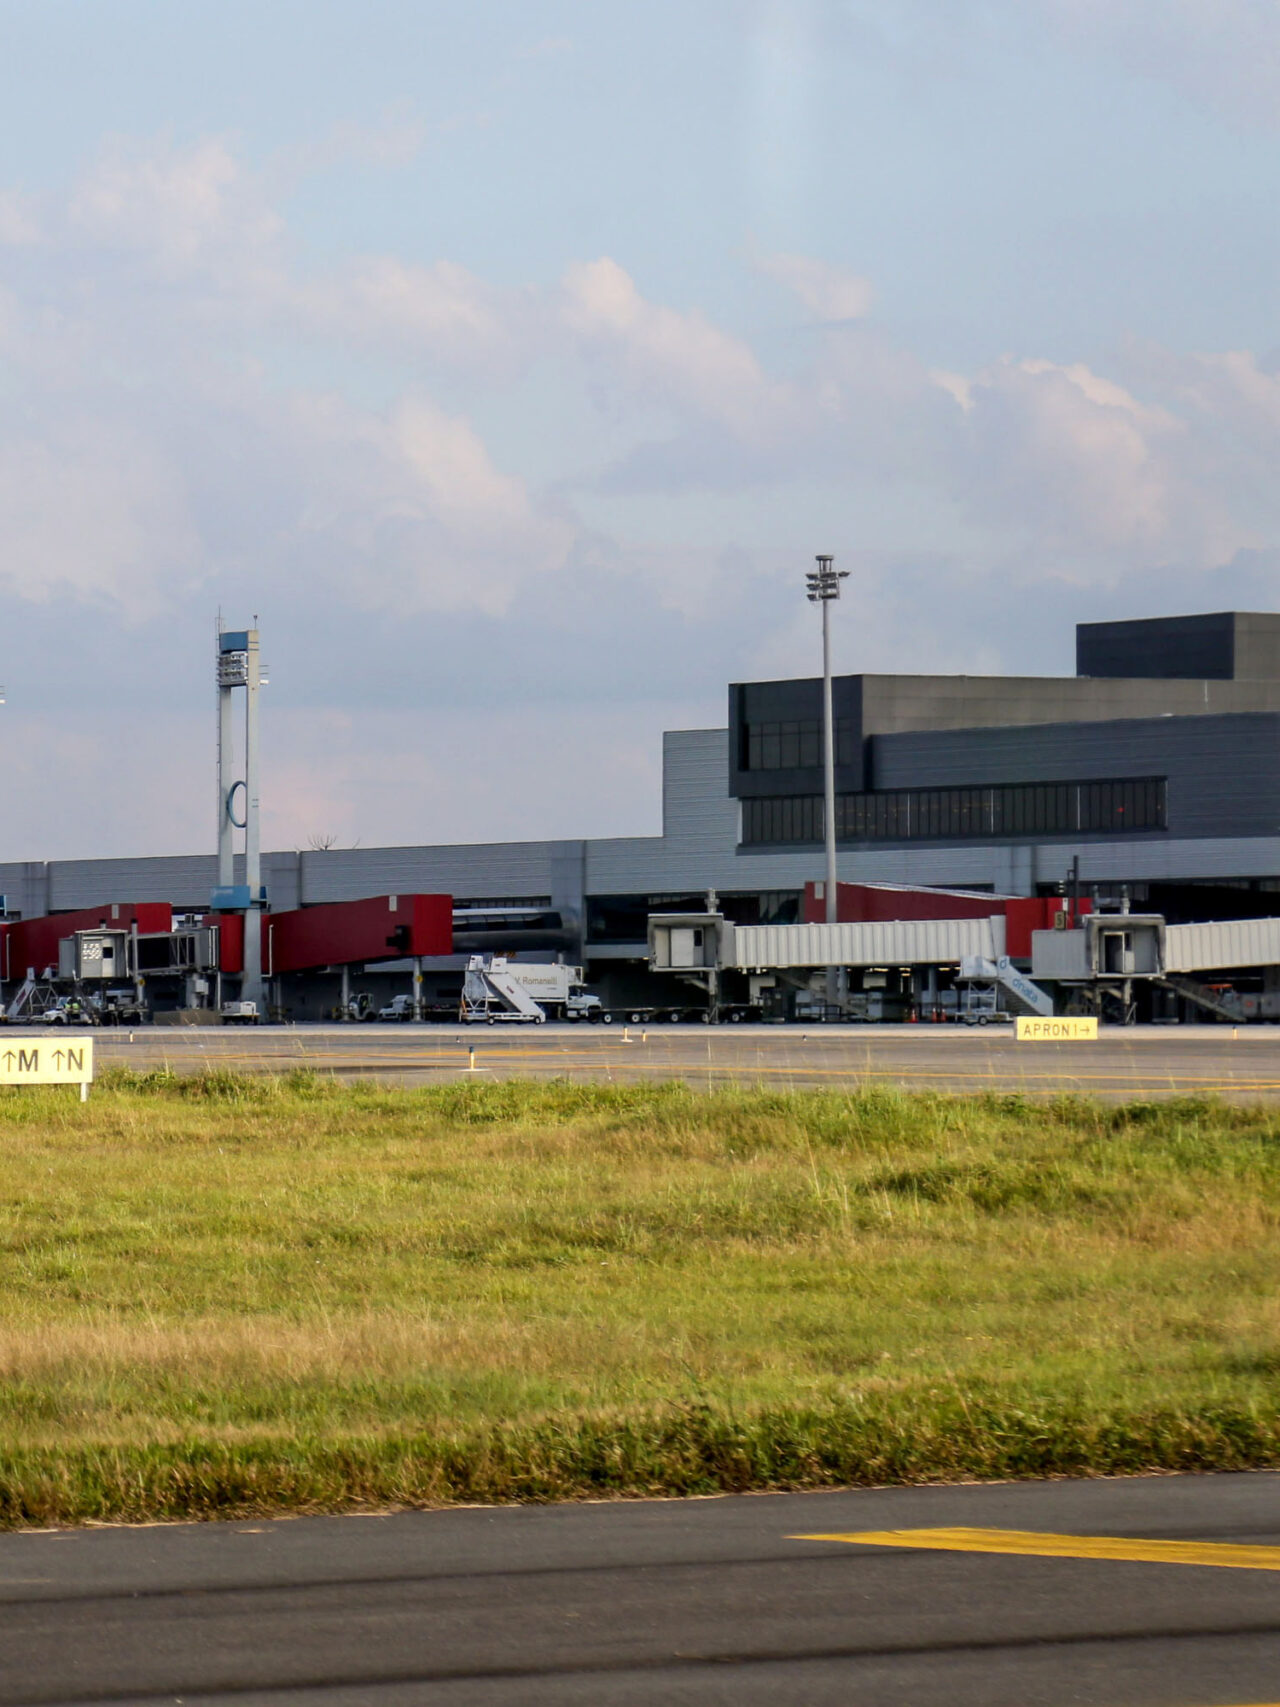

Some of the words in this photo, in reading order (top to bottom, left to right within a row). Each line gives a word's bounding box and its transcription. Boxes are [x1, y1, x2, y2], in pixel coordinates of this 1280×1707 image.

[522, 976, 558, 985] Romanelli
[1011, 977, 1038, 1003] dnata
[1023, 1023, 1070, 1037] APRON
[18, 1049, 39, 1072] M
[67, 1048, 84, 1071] N
